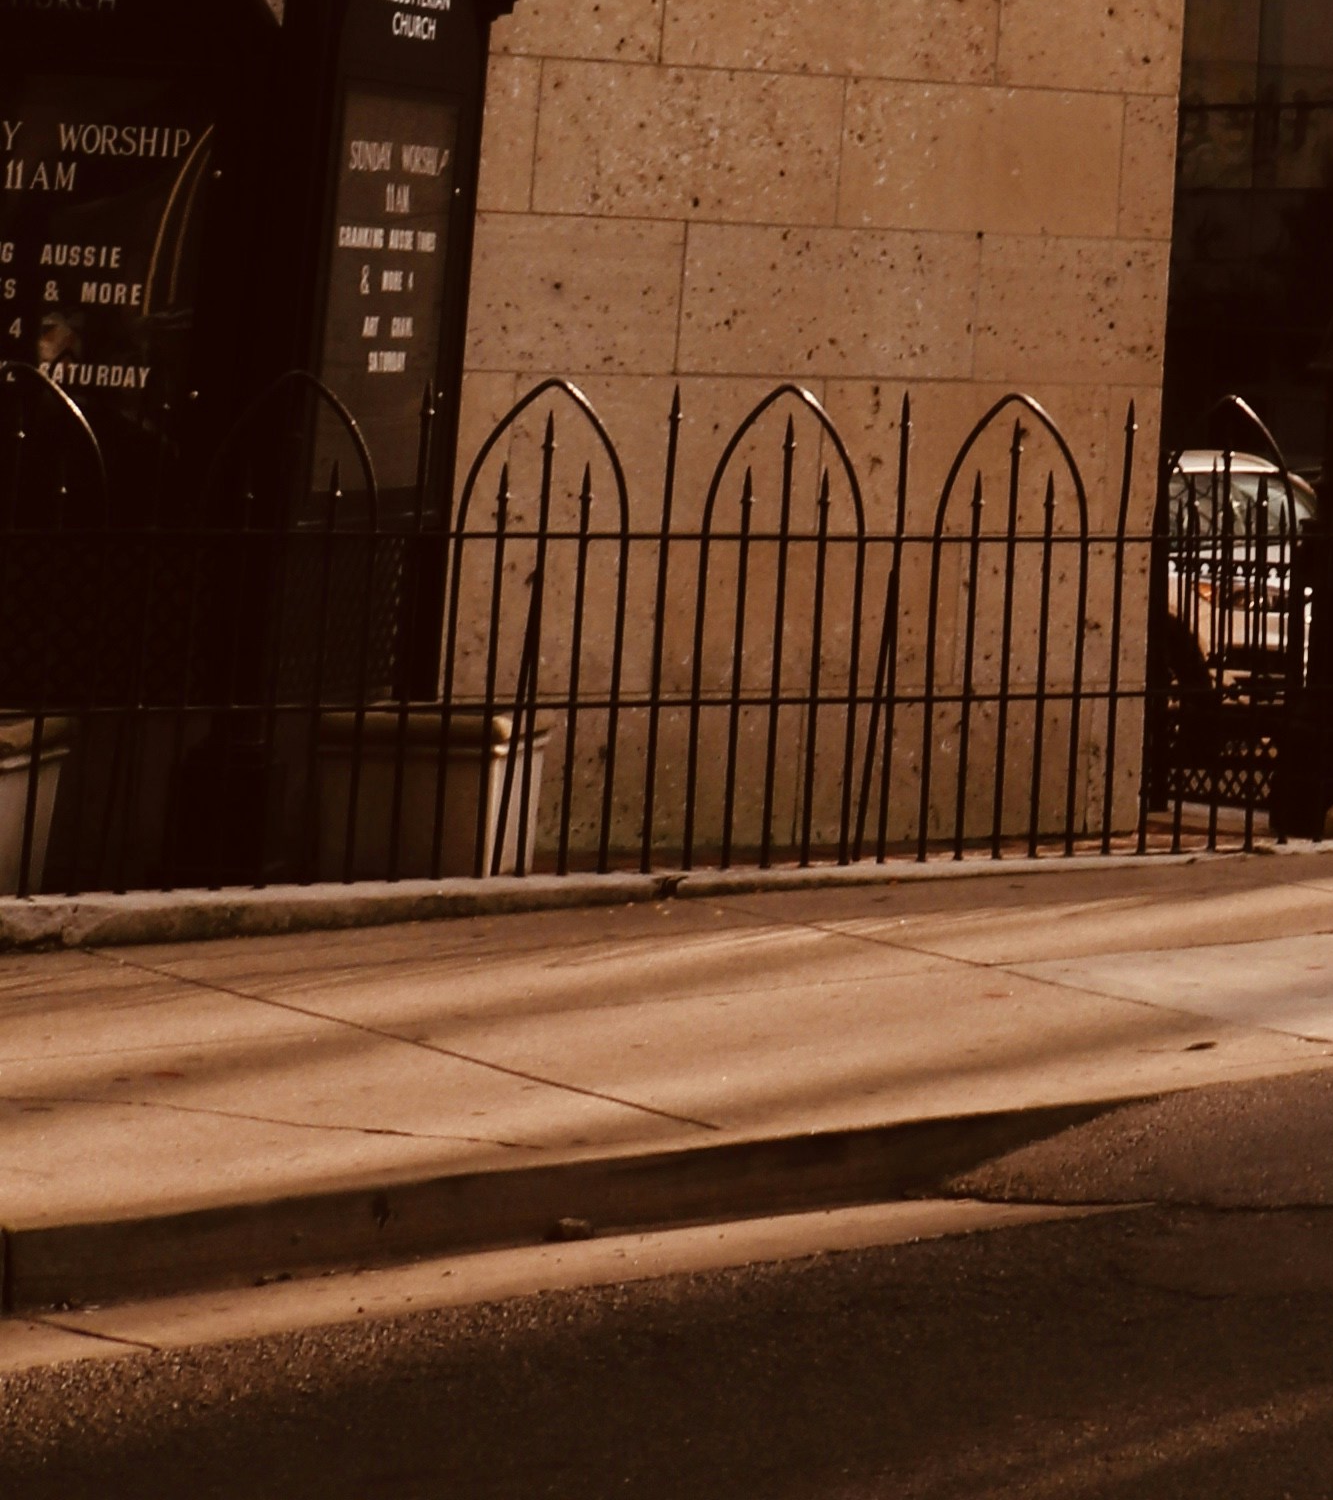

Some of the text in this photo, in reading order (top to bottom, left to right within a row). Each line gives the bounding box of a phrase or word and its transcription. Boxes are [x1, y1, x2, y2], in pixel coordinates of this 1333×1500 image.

[392, 11, 437, 41] CHURCH
[57, 122, 191, 159] WORSHIP
[348, 140, 393, 171] SUNDAY
[39, 242, 123, 269] AUSSIE
[43, 279, 60, 302] &
[80, 281, 142, 307] MORE
[360, 264, 371, 294] &
[8, 316, 23, 339] 4
[38, 360, 151, 390] SATURDAY
